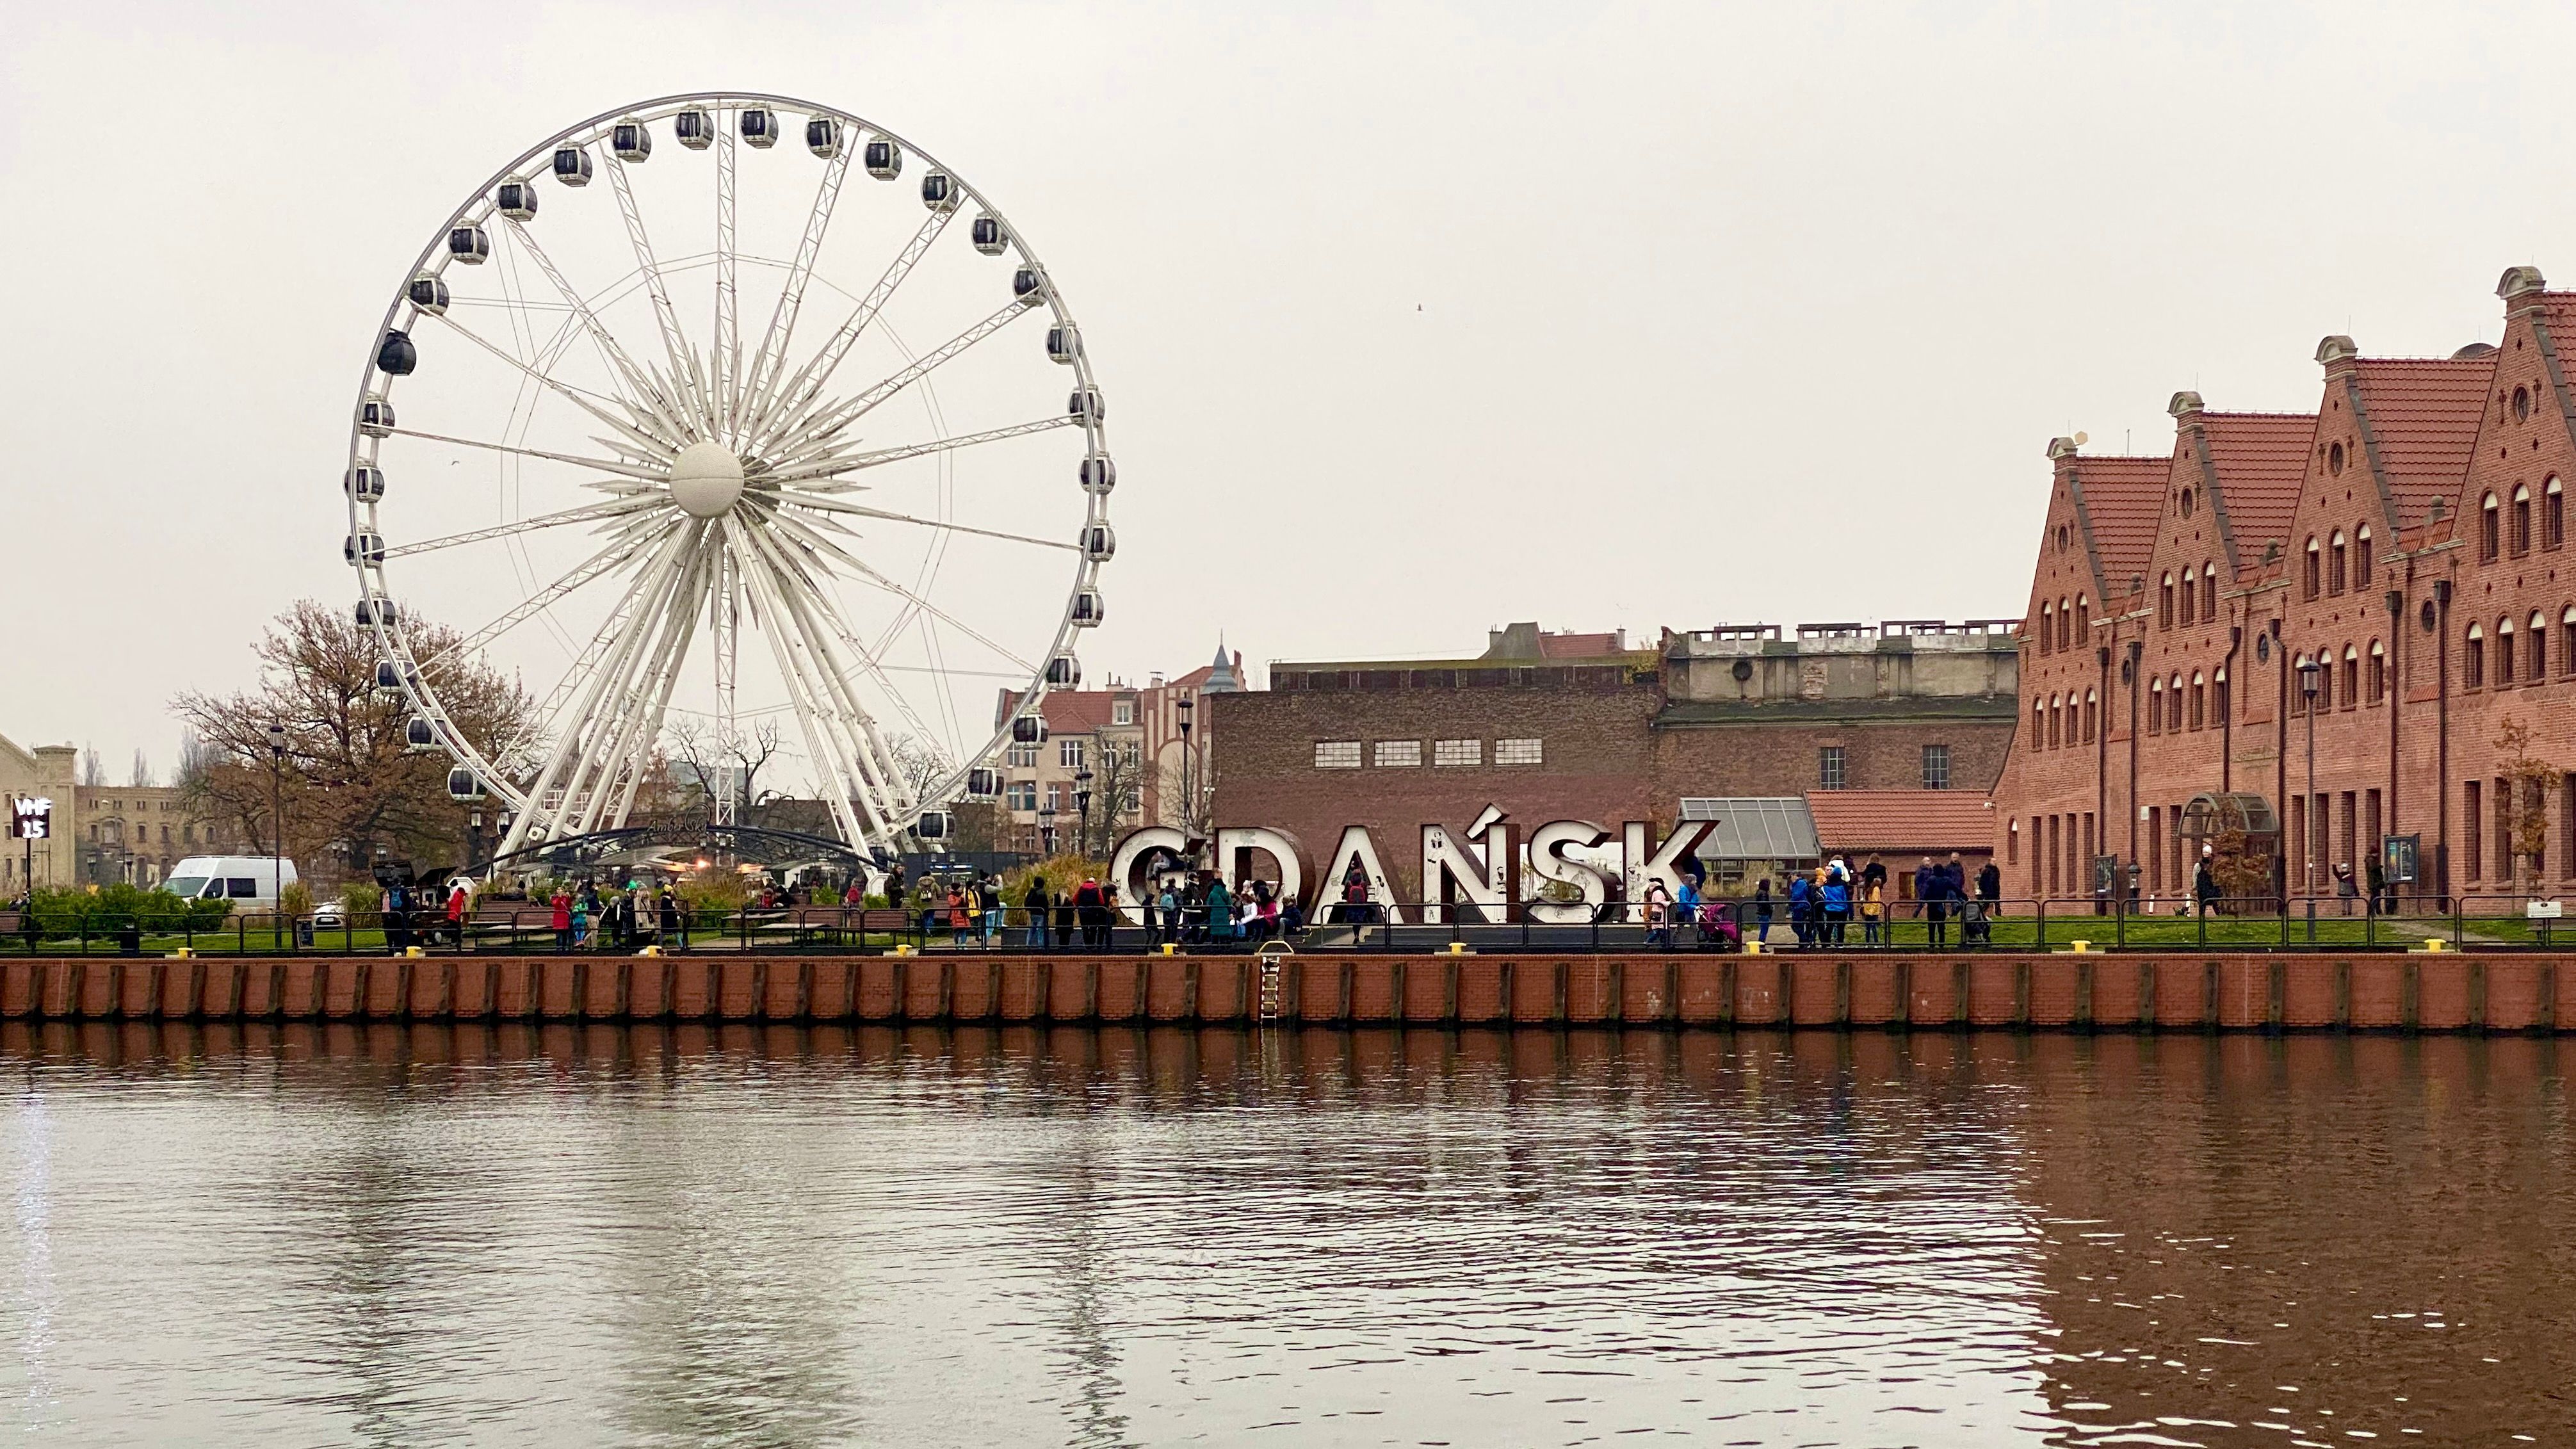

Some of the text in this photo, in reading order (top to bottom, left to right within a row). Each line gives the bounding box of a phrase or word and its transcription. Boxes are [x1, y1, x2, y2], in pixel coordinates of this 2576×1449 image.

[14, 798, 52, 816] VHF
[22, 820, 44, 838] 15
[647, 817, 681, 832] Amber
[1108, 802, 1720, 926] GDAŃSK
